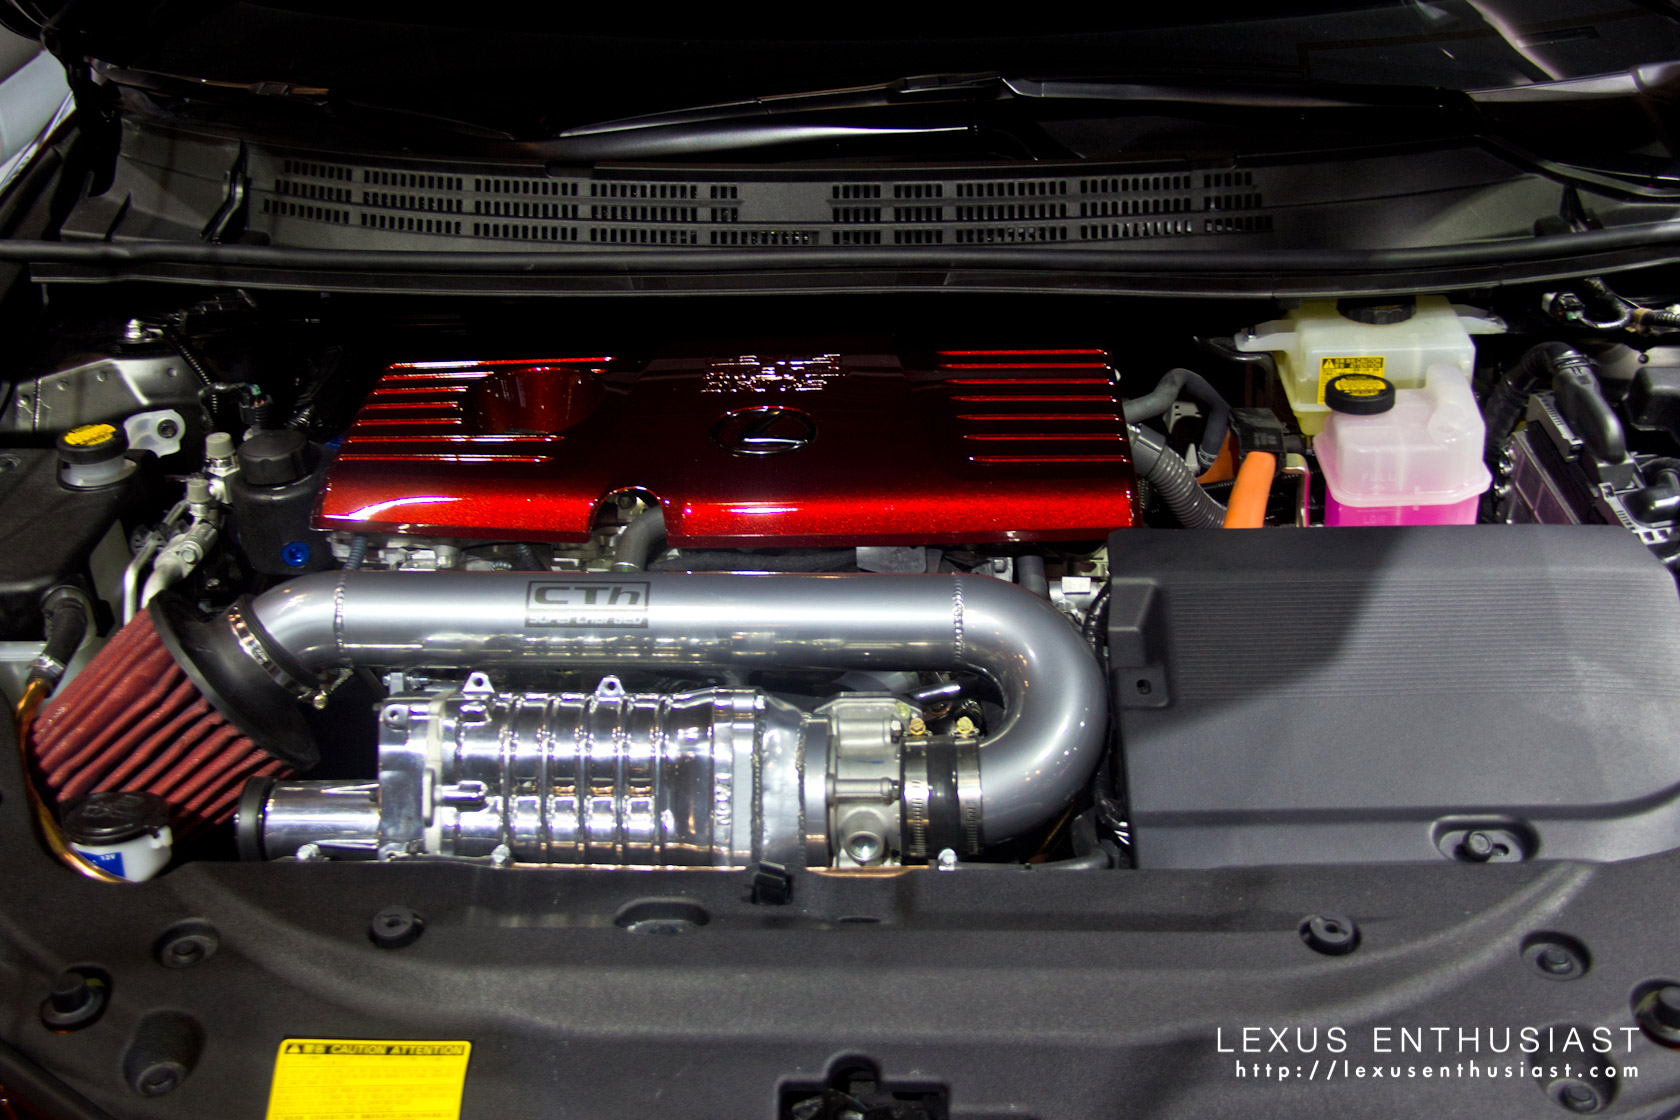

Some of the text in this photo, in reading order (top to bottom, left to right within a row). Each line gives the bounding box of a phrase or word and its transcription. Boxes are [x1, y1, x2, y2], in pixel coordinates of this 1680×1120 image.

[1361, 472, 1394, 482] FULL
[534, 586, 641, 605] CTh
[329, 1044, 387, 1054] CAUTION
[389, 1044, 464, 1055] ATTENTION
